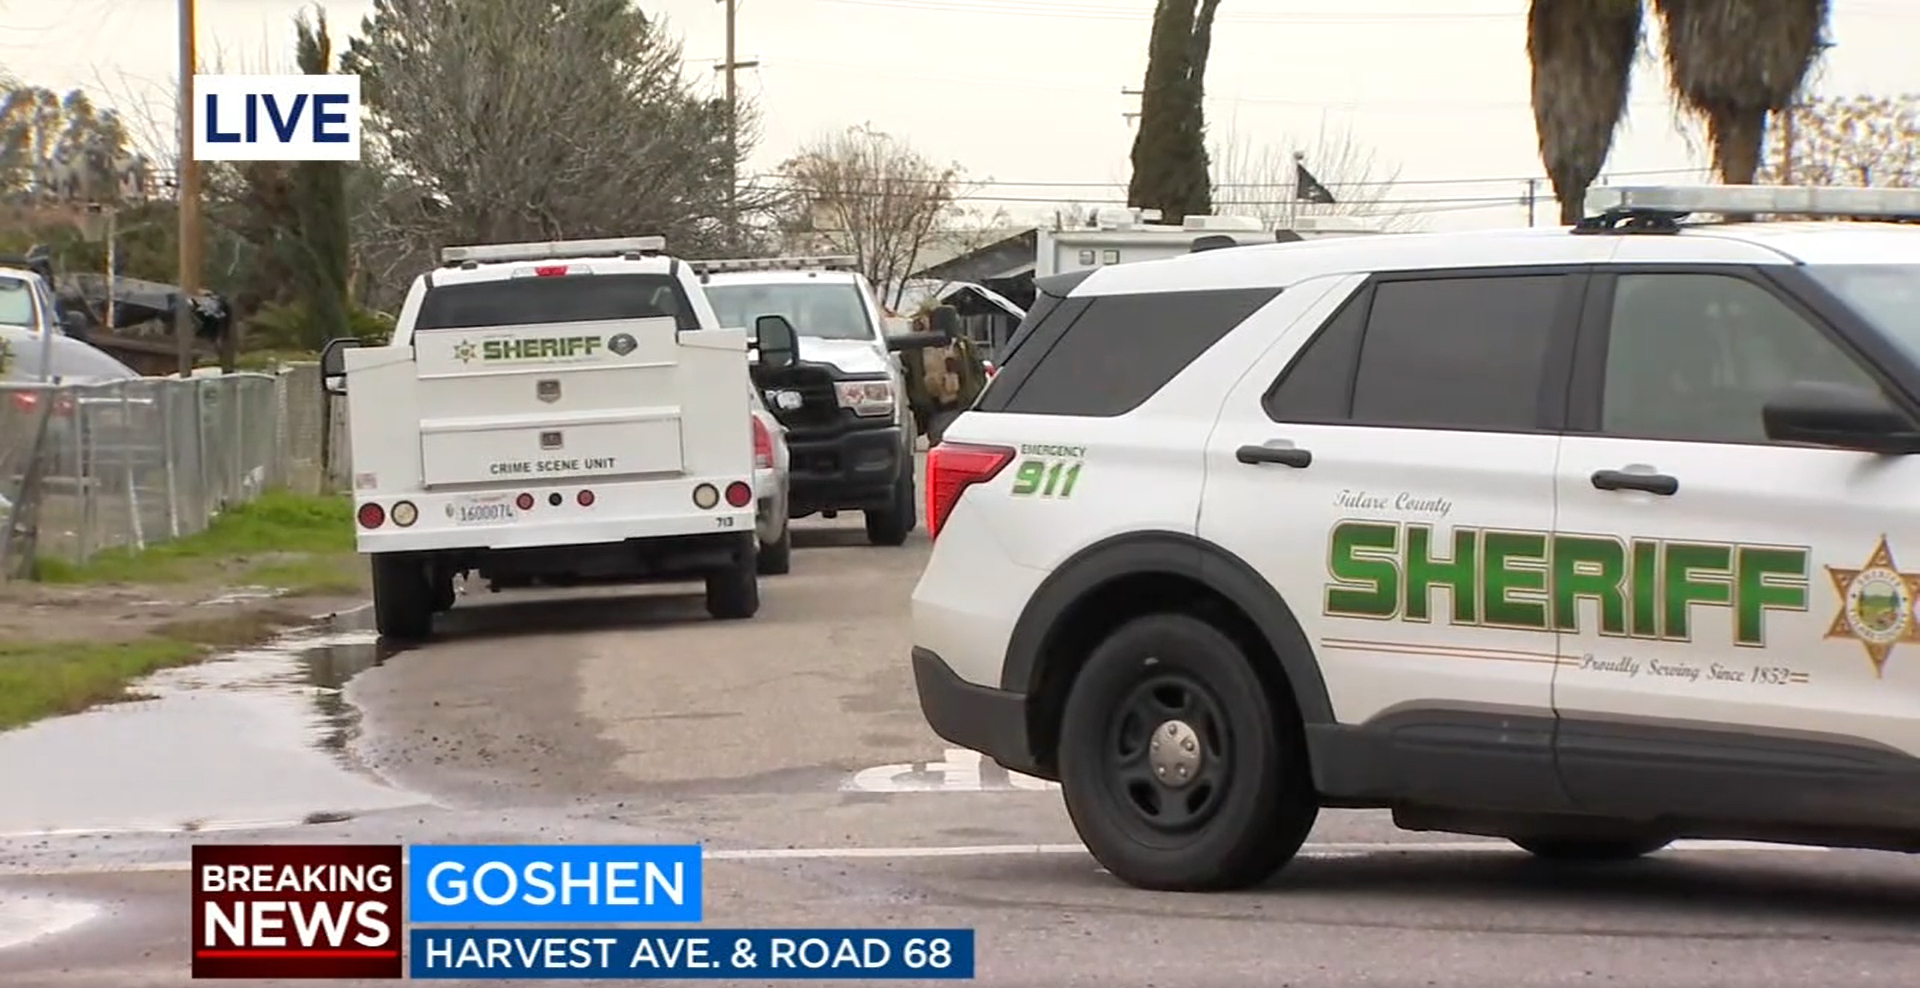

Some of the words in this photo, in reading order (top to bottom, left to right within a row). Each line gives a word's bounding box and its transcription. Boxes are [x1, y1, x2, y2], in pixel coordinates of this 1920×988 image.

[483, 335, 602, 360] SHERIFF
[1021, 443, 1087, 458] EMERGENCY
[490, 461, 531, 475] CRIME
[536, 459, 579, 472] SCENE
[584, 457, 616, 470] UNIT
[1011, 458, 1084, 499] 911
[1333, 488, 1388, 510] Tulare
[1395, 491, 1453, 516] County
[715, 516, 734, 528] 713
[1323, 518, 1812, 647] SHERIFF
[1580, 652, 1640, 678] Proudly
[1648, 658, 1701, 682] Serving
[1706, 662, 1745, 682] Since
[1750, 664, 1791, 685] 1852
